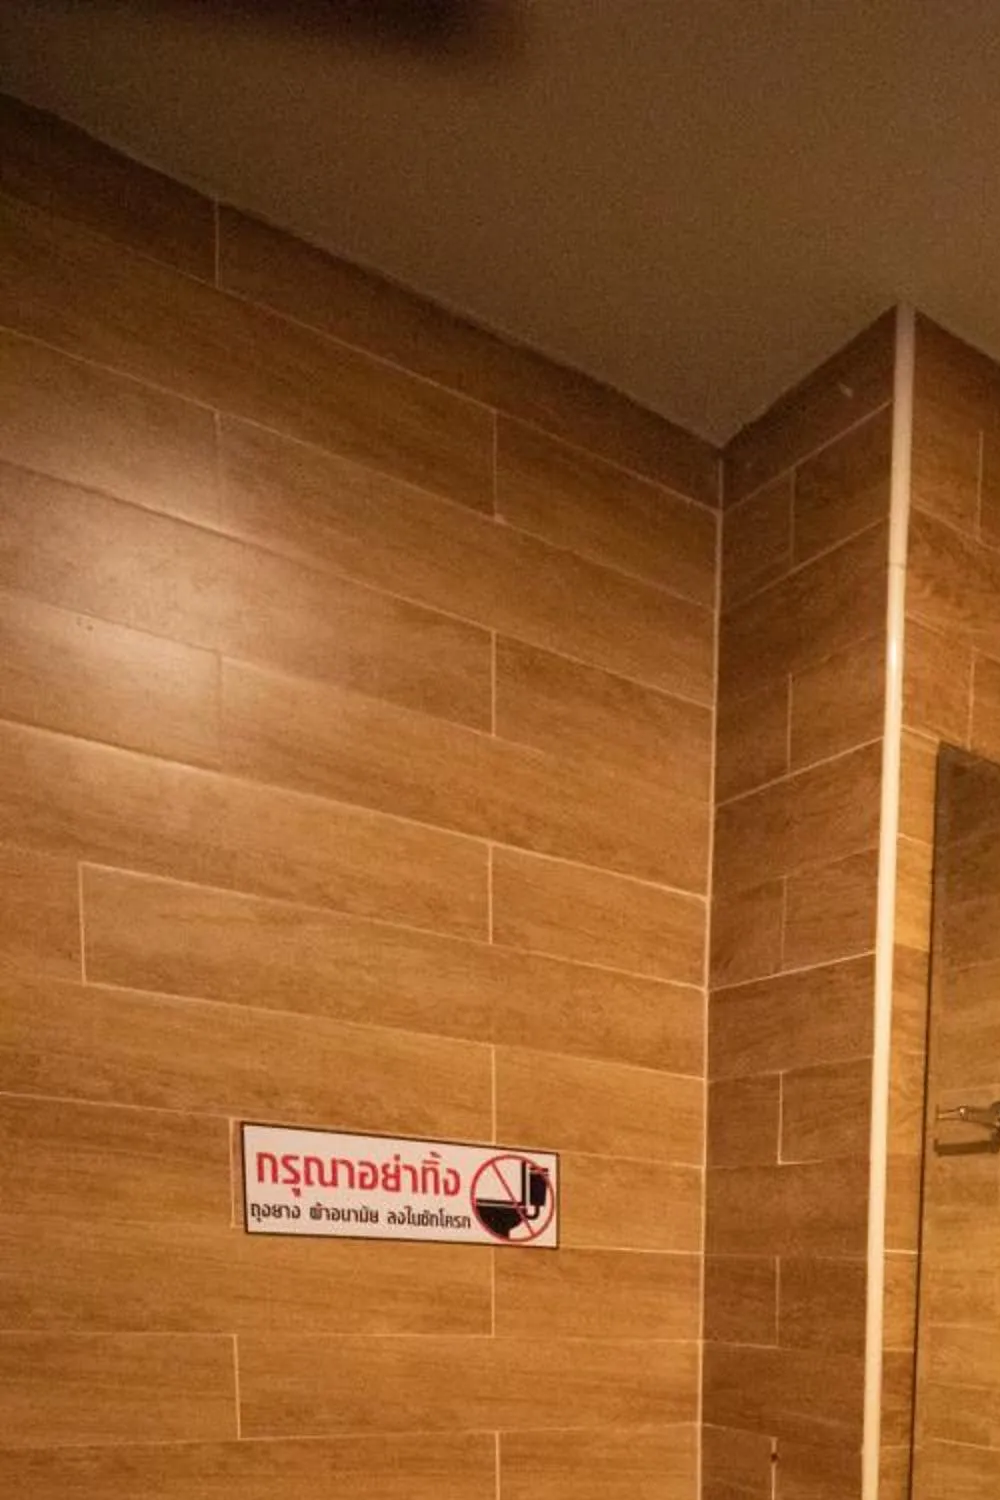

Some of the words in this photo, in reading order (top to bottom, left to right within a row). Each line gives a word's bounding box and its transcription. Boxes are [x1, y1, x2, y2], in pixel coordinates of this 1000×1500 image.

[256, 1151, 461, 1197] กรุณาอย่าทิ้ง
[250, 1203, 301, 1223] ถุงยาง
[309, 1202, 379, 1224] ผ้าอนามัย
